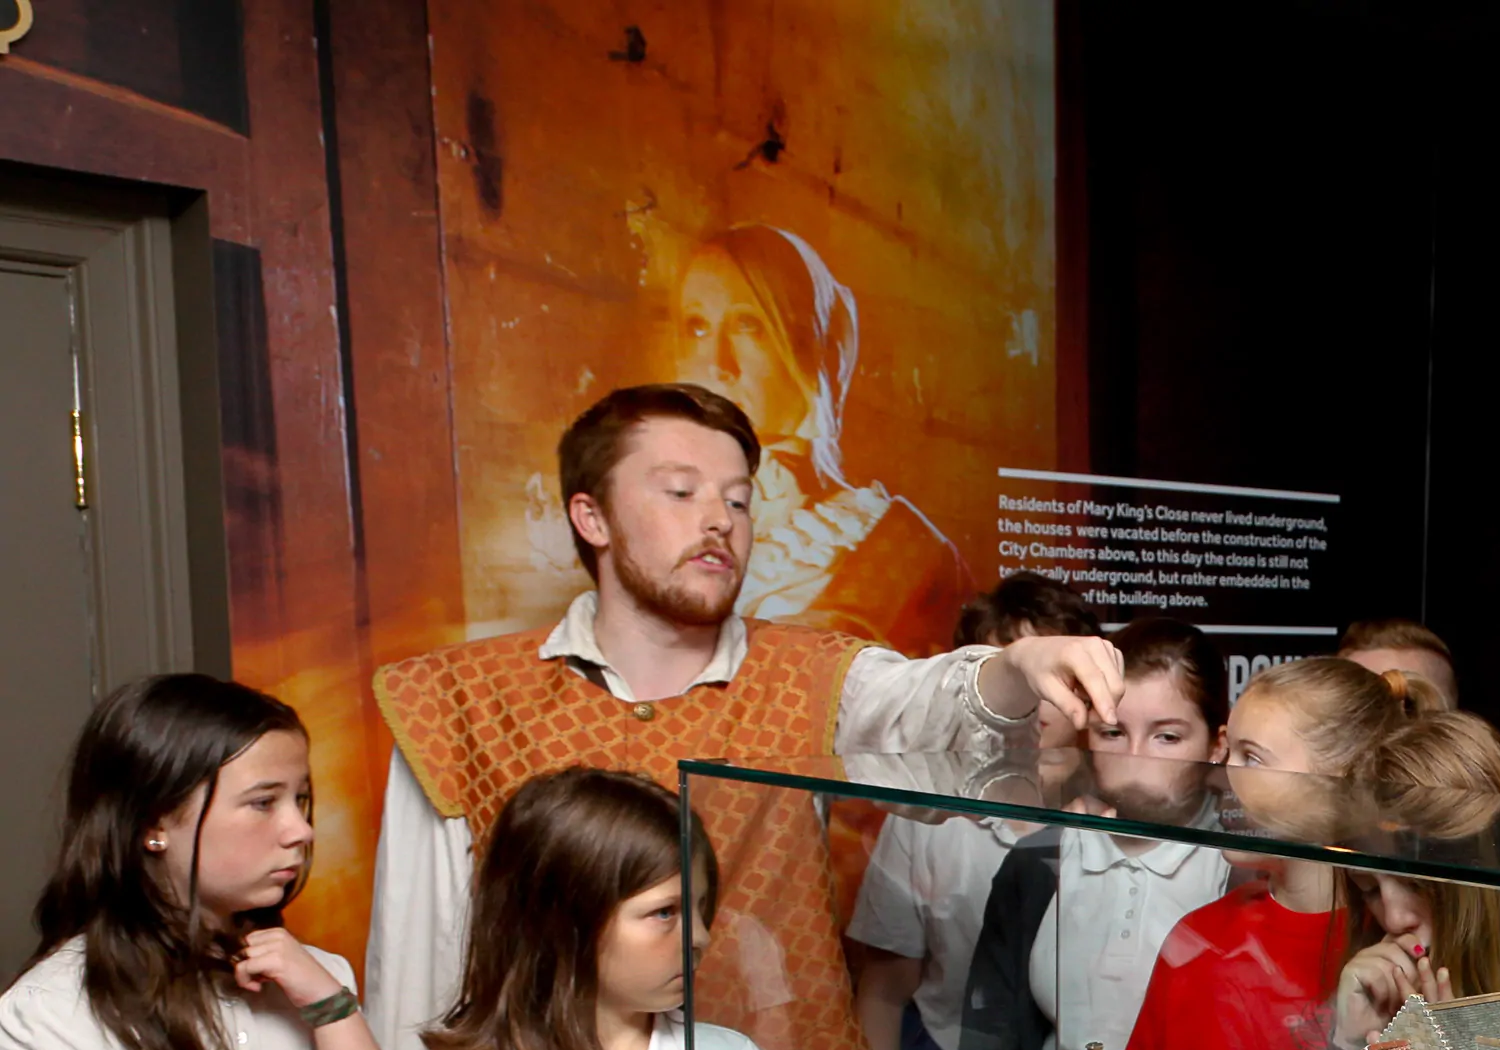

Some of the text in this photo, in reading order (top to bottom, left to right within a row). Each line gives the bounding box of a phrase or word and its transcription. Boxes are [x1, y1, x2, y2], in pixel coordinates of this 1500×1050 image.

[998, 493, 1326, 531] Residents of Mary King's Close never lived underground,
[996, 517, 1327, 550] the houses were vacated before the construction of the
[998, 540, 1308, 569] City Chambers above, to this day the close is still not
[998, 564, 1310, 589] teically underground, but rather embedded in the
[1095, 589, 1118, 604] the
[1119, 590, 1168, 609] building
[1169, 592, 1208, 606] above.
